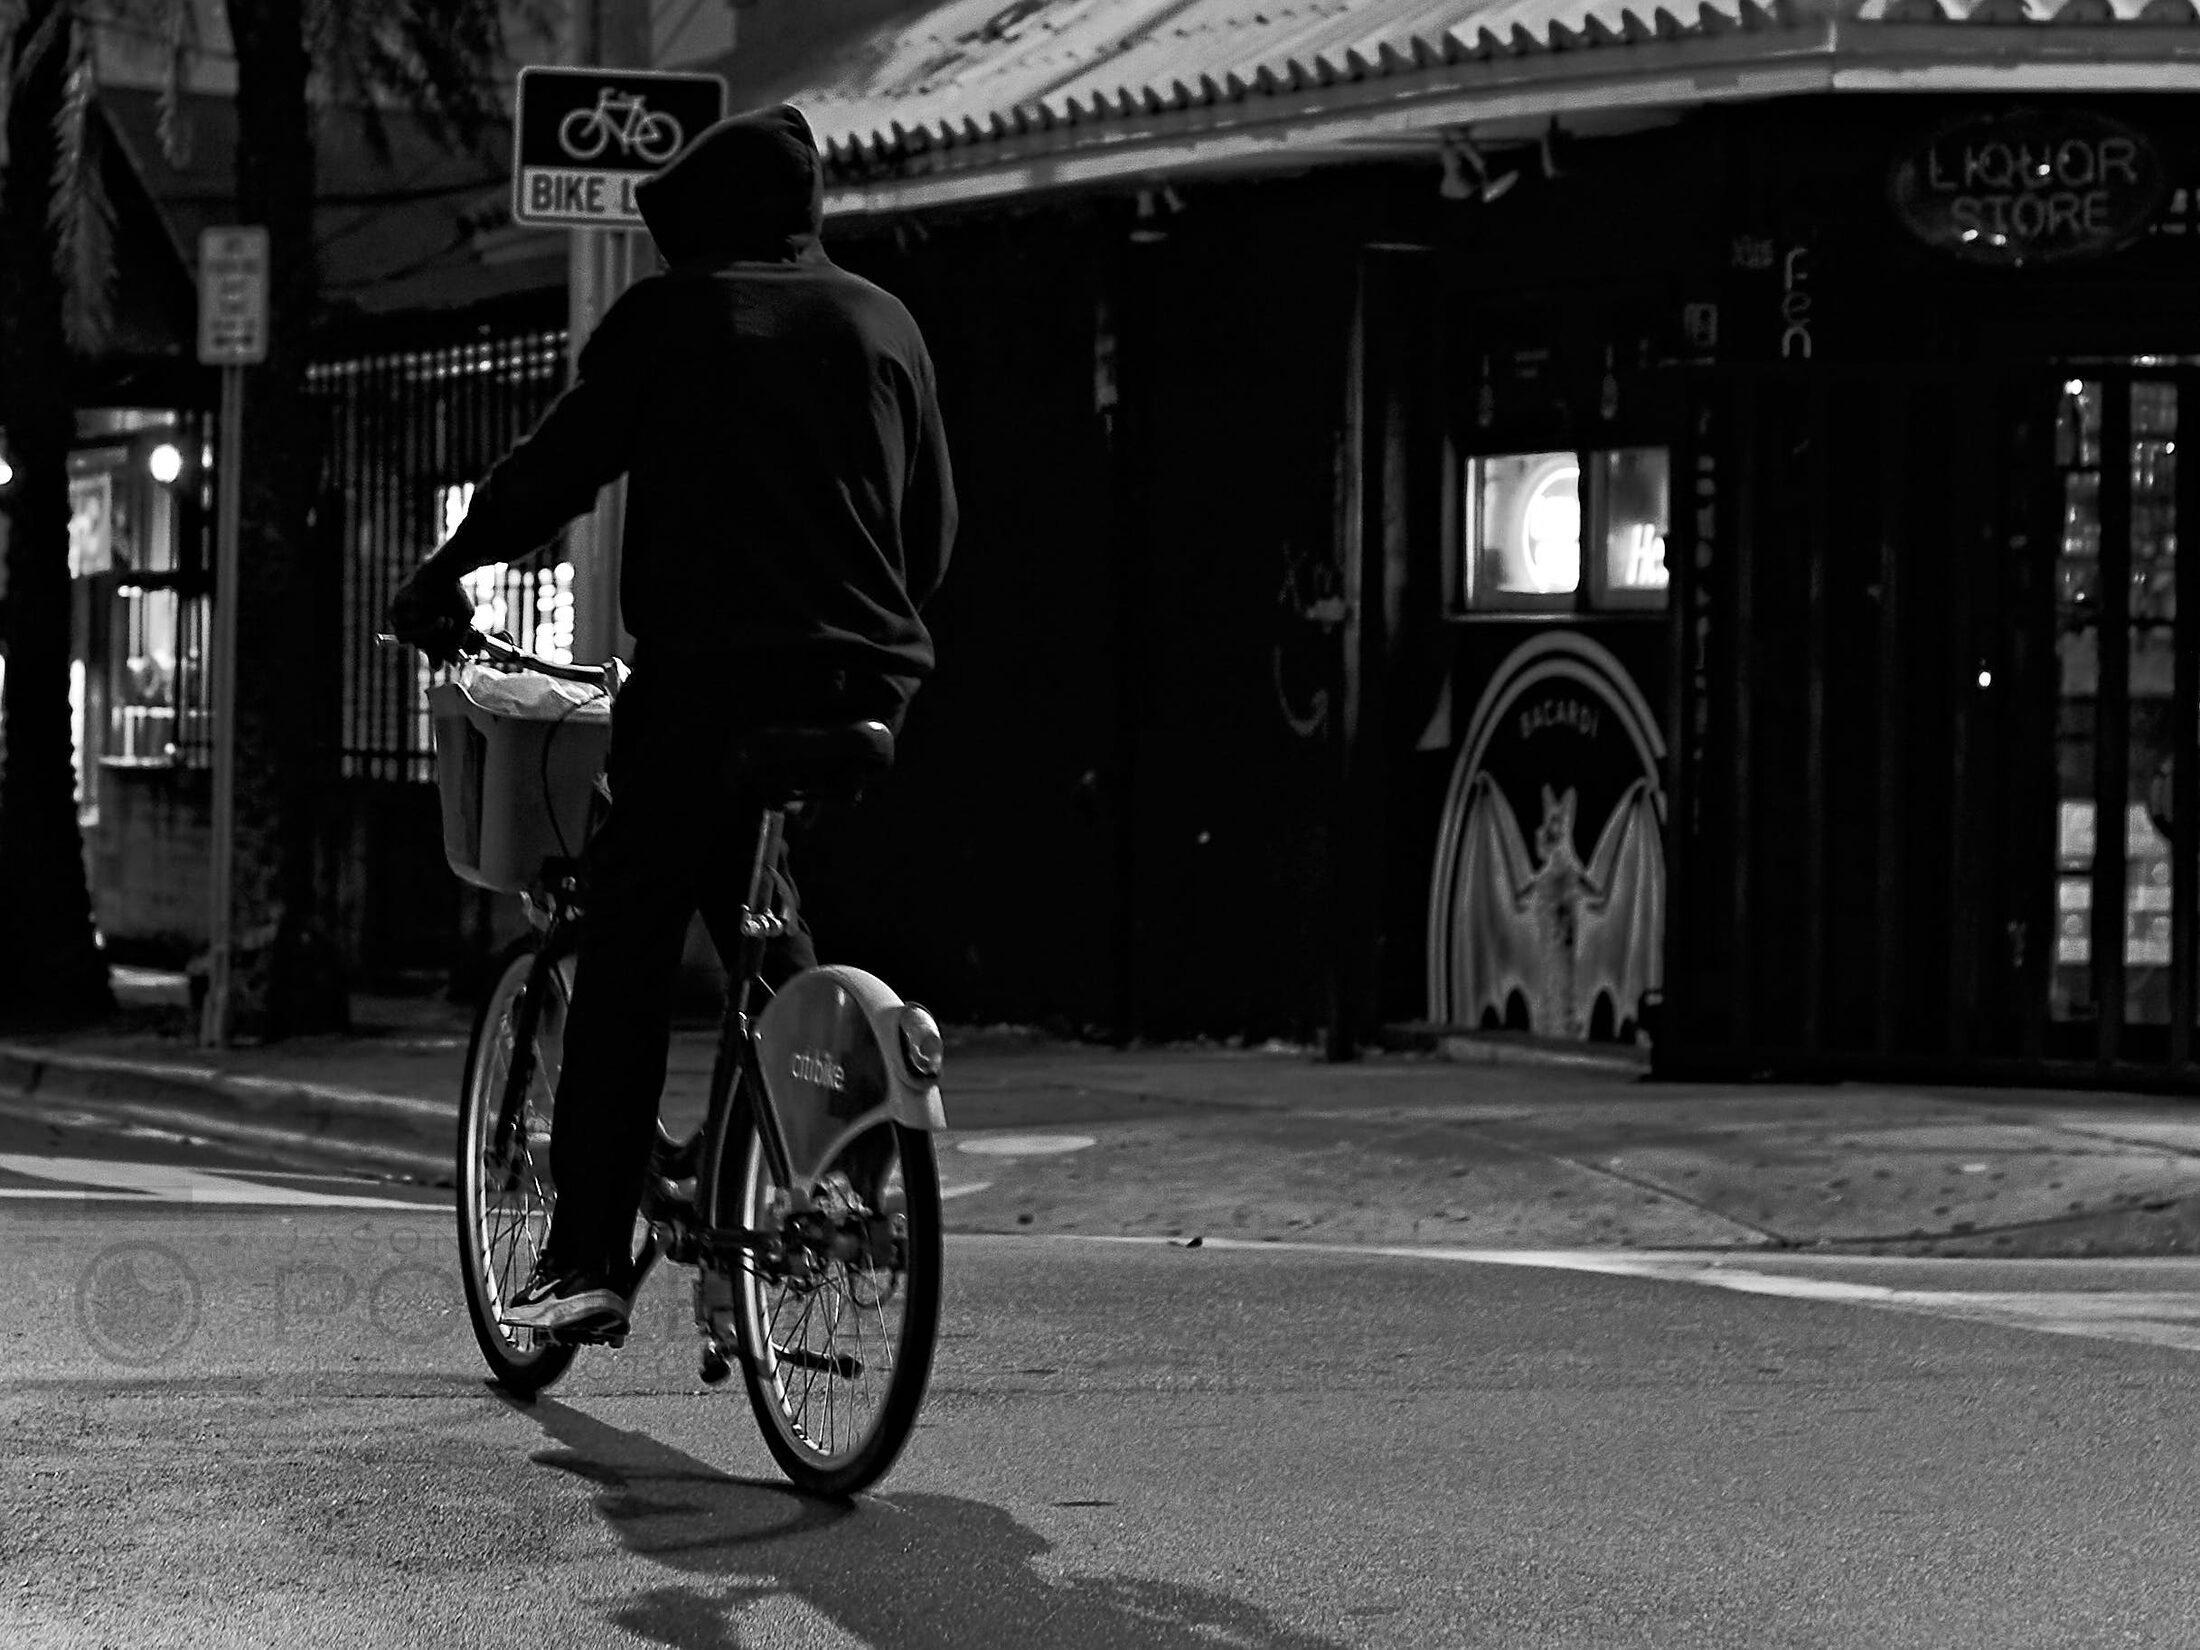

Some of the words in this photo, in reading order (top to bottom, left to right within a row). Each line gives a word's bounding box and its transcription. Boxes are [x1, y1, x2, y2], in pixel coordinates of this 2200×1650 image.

[1928, 137, 2138, 190] LIQUOR
[531, 173, 605, 214] BIKE
[622, 178, 640, 214] L
[1949, 189, 2113, 243] STORE
